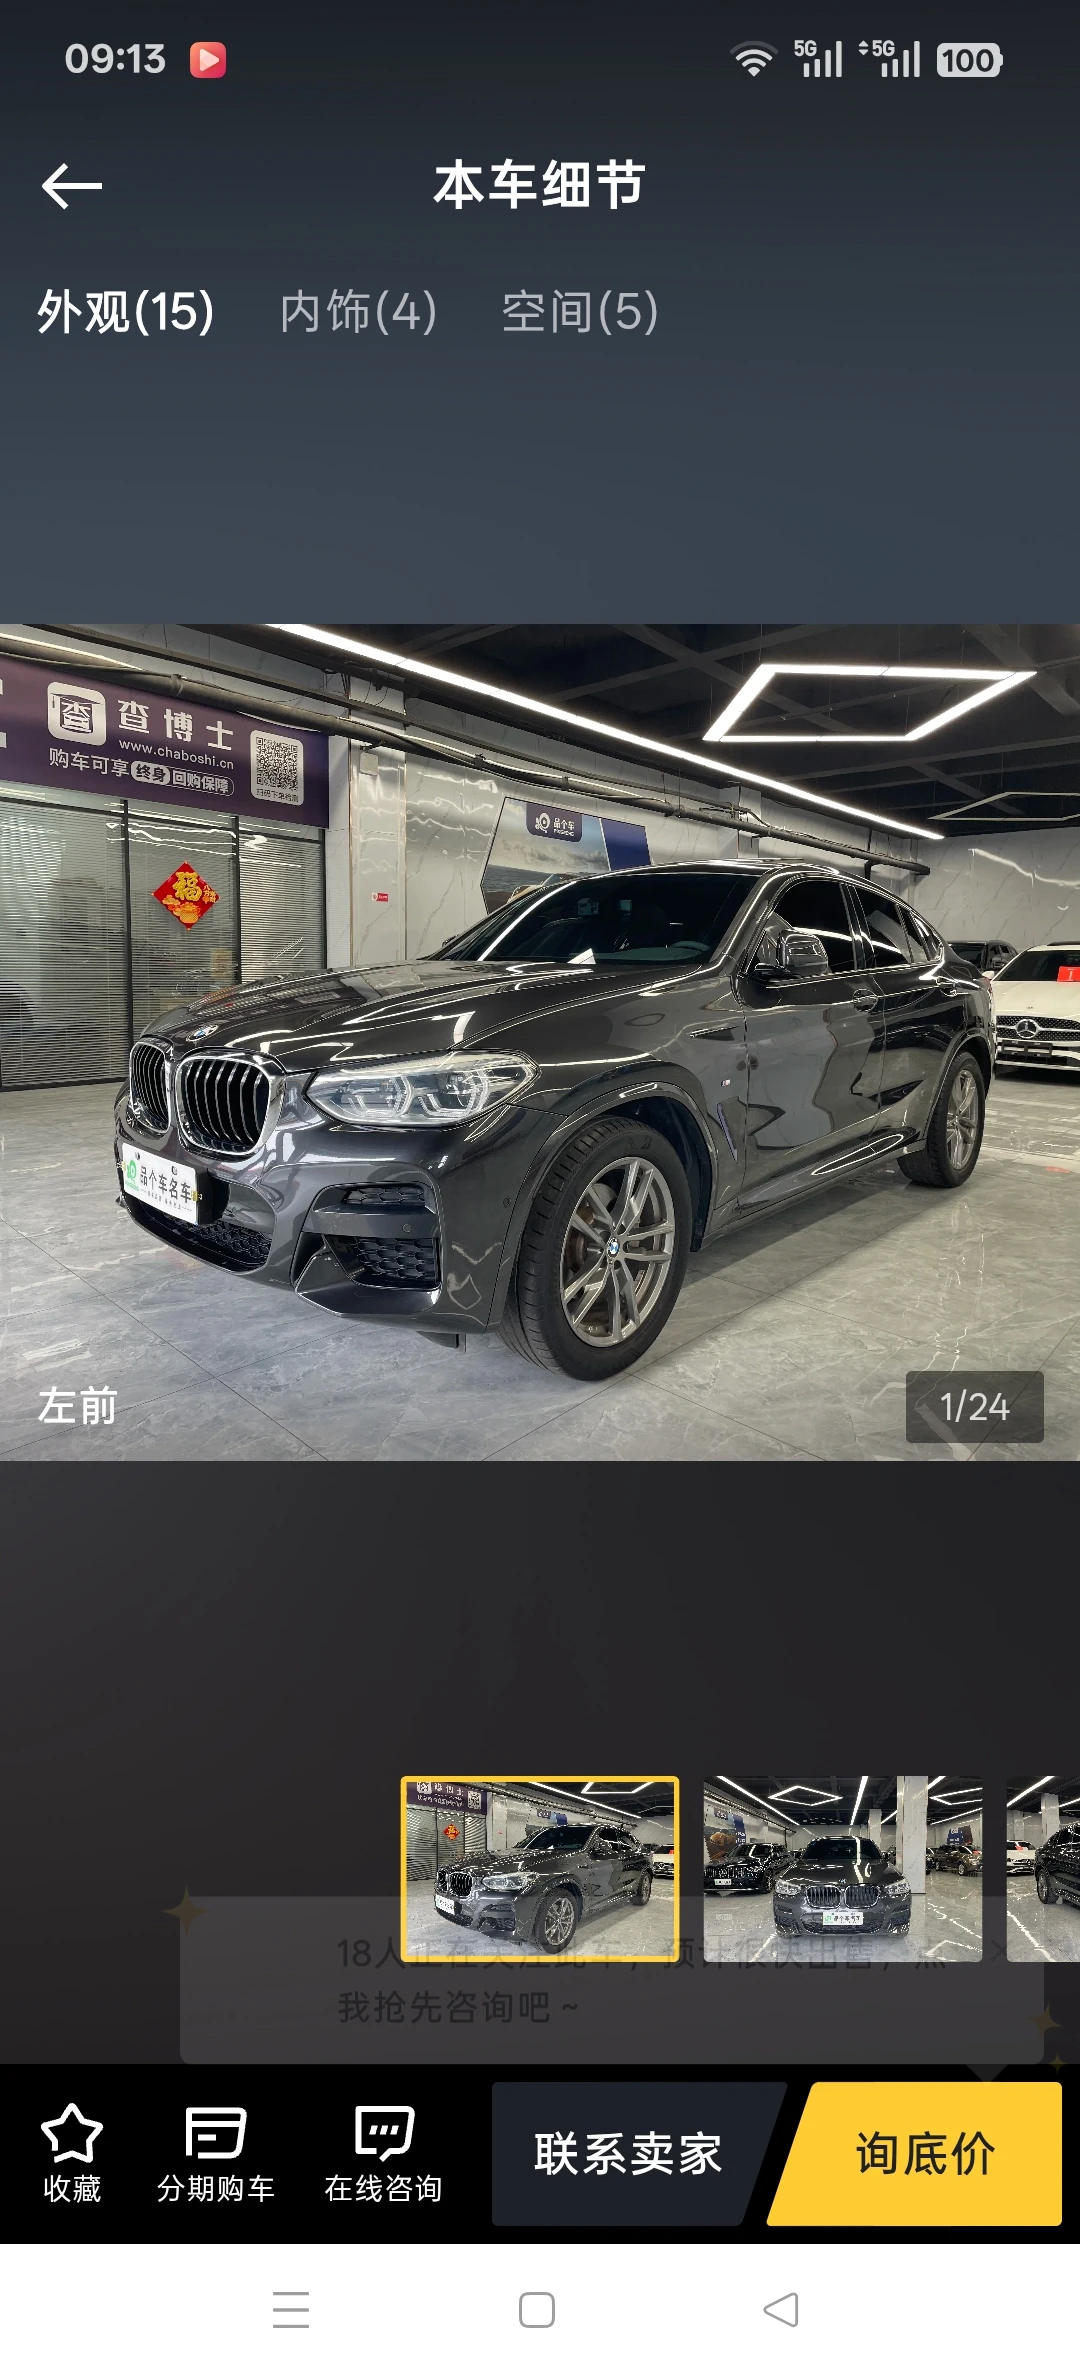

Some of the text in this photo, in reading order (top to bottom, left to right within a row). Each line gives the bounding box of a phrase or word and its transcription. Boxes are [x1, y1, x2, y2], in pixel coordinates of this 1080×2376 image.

[65, 43, 166, 74] 09:13
[794, 39, 818, 57] 5G
[871, 39, 896, 57] 5G
[941, 48, 995, 73] 100
[433, 158, 646, 209] 本车细节
[37, 288, 214, 336] 外观(15)
[281, 288, 437, 336] 内饰(4)
[502, 288, 658, 336] 空间(5)
[117, 699, 234, 751] 查博士
[118, 739, 234, 769] www.chaboshi.cn
[553, 817, 575, 831] 品个车
[172, 871, 202, 902] 福
[140, 1165, 192, 1204] 品个车名车
[533, 2130, 723, 2176] 联系卖家
[856, 2130, 996, 2176] 询底价
[43, 2174, 102, 2204] 收藏
[157, 2174, 275, 2204] 分期购车
[324, 2174, 442, 2204] 在线咨询
